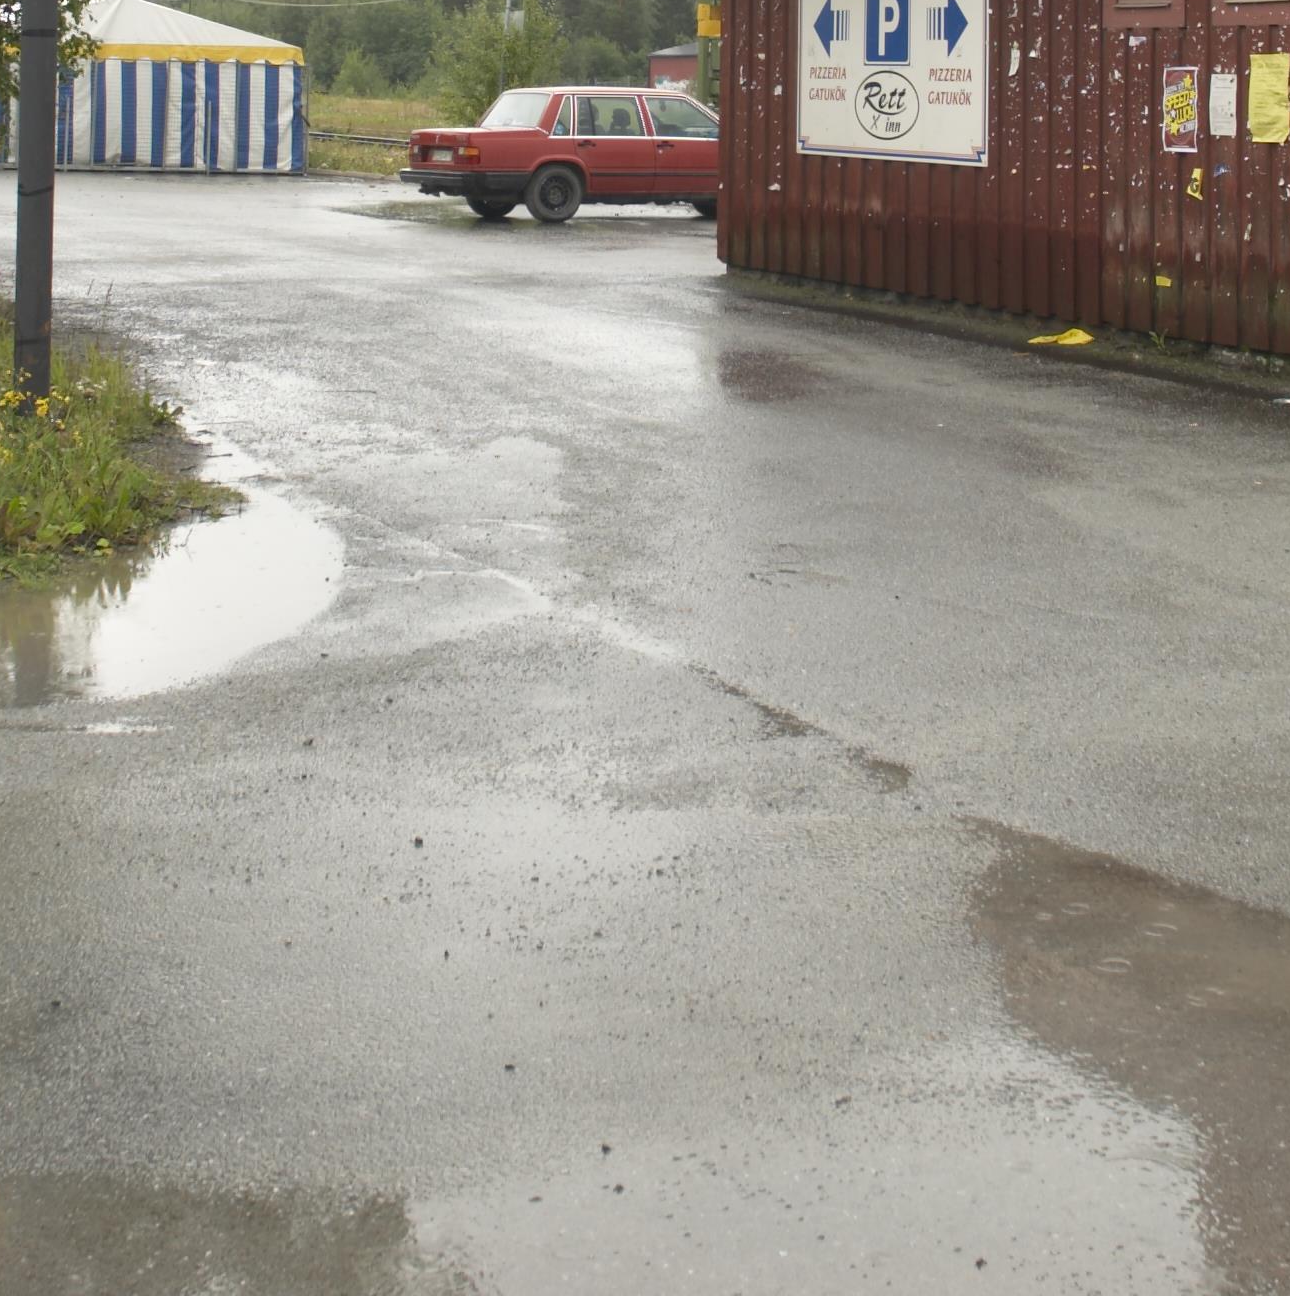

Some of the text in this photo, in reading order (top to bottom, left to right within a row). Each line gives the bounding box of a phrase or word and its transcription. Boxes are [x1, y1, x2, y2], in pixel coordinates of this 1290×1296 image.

[809, 66, 847, 80] PIZZERIA
[928, 67, 972, 83] PIZZERIA
[809, 86, 847, 101] GATUKÖK
[862, 81, 908, 116] Rett
[927, 90, 972, 106] GATUKÖK
[885, 119, 901, 133] inn
